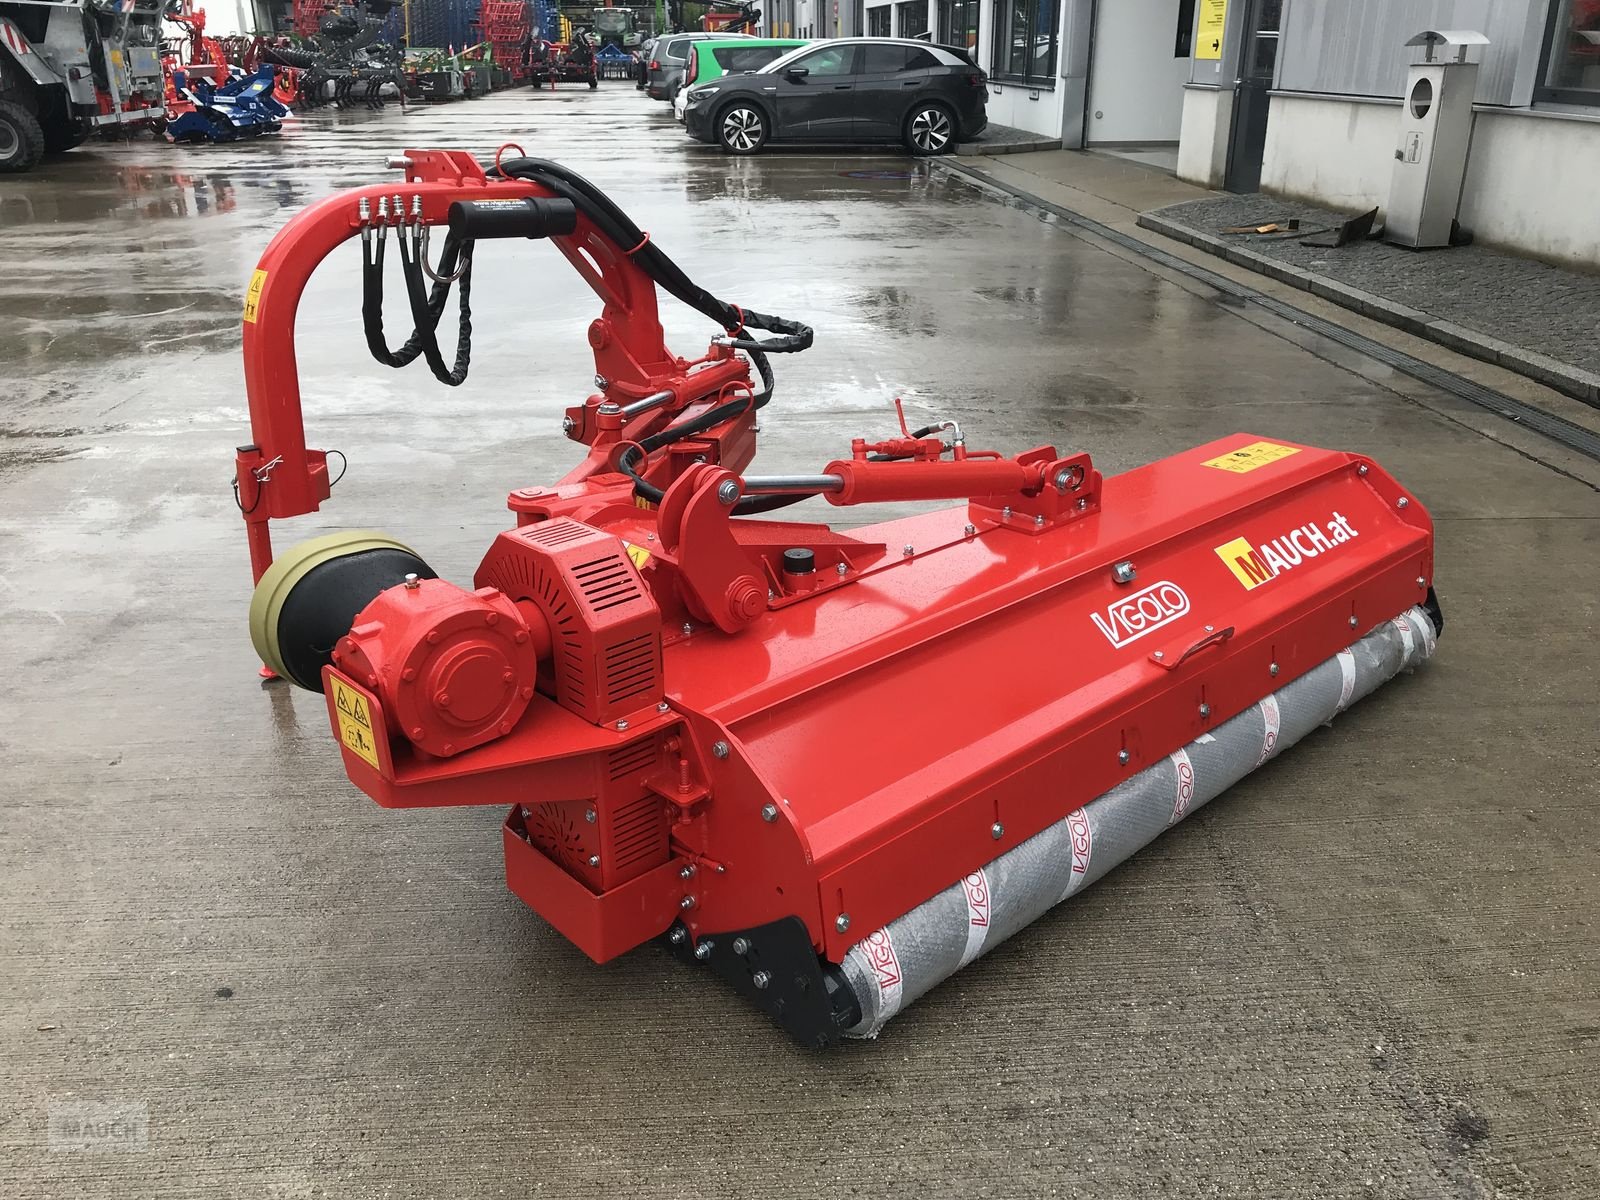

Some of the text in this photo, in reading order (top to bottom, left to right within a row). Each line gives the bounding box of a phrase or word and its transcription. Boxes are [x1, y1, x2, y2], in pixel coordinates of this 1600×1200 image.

[1234, 511, 1360, 591] MAUCH.at
[1090, 580, 1191, 649] VIGOLO
[963, 868, 988, 927] VIGO
[866, 929, 901, 990] VIGO
